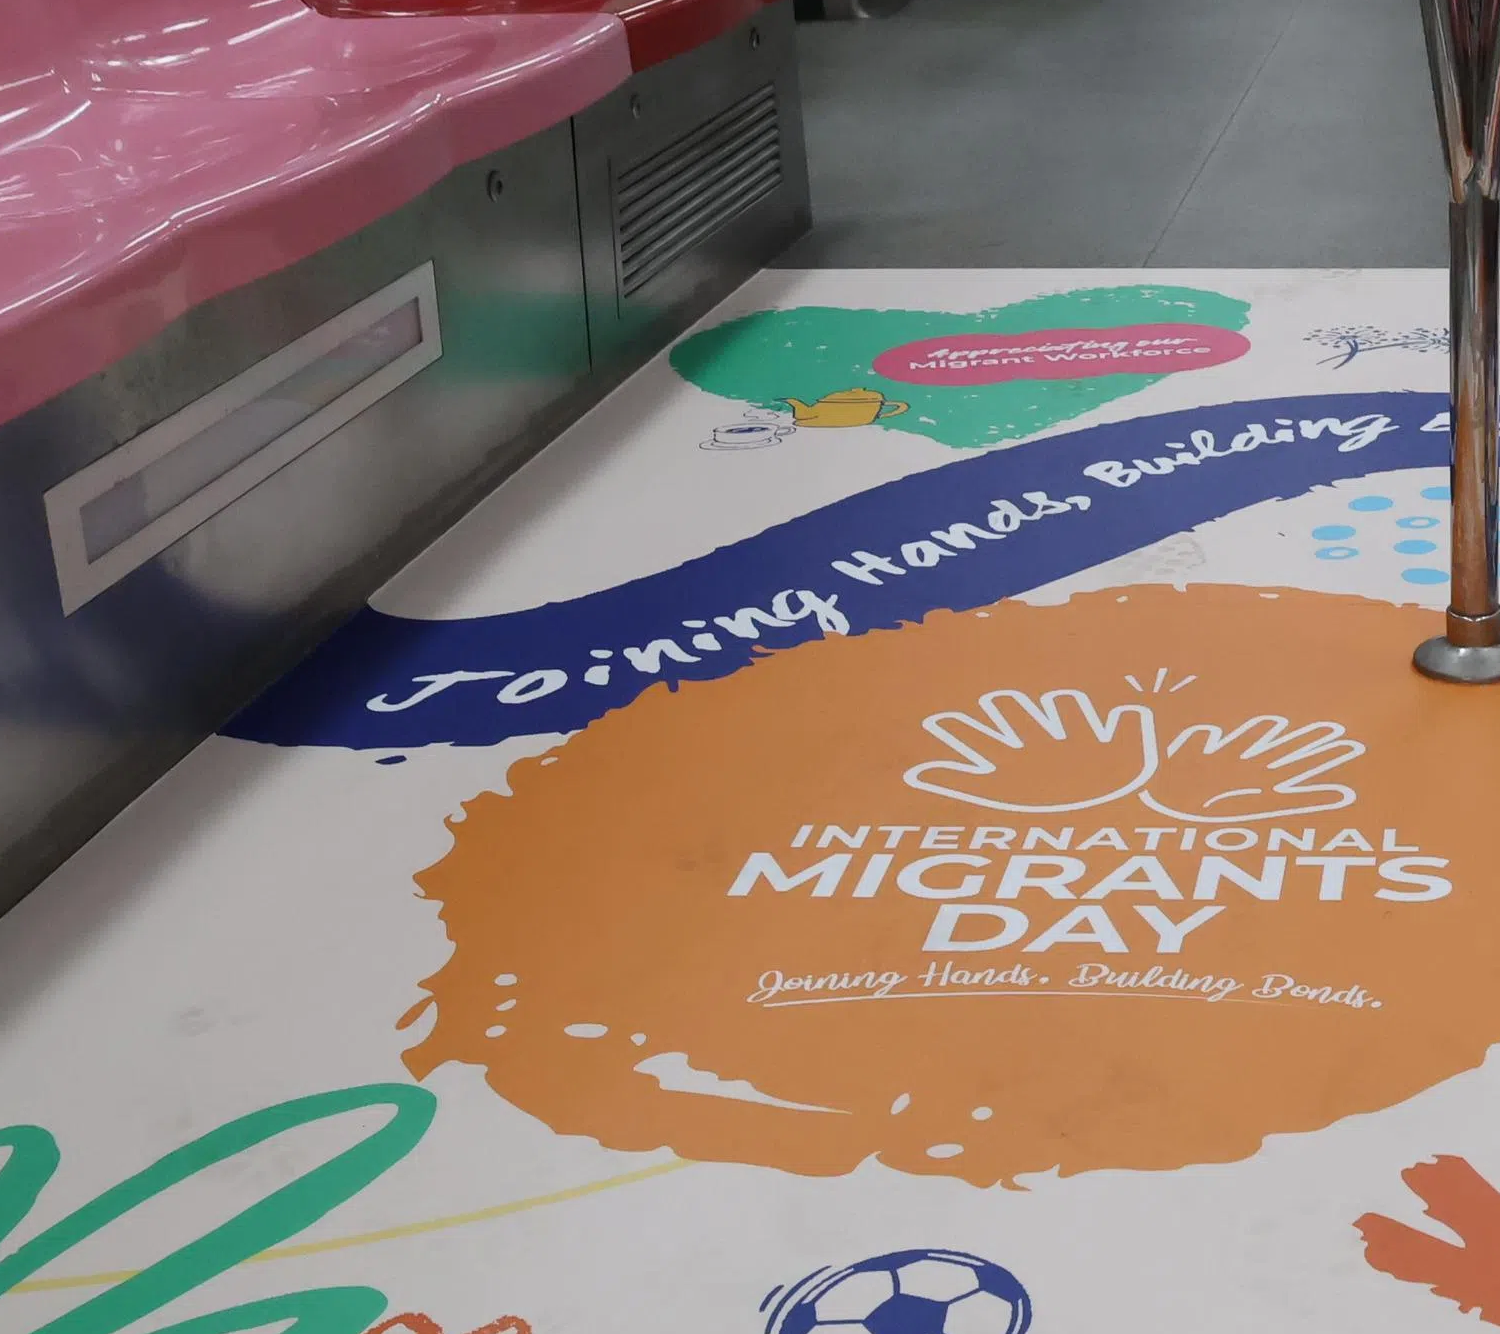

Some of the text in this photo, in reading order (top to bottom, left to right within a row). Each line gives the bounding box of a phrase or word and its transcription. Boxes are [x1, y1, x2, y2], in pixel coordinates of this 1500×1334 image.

[909, 344, 1212, 370] Migrant Workforce
[927, 335, 1198, 361] Appreciating our
[366, 588, 849, 713] Joining
[831, 491, 1091, 586] Hands,
[1083, 412, 1400, 489] Building
[790, 824, 1421, 853] INTERNATIONAL
[726, 853, 1454, 903] MIGRANTS
[921, 903, 1228, 955] DAY
[747, 961, 1383, 1009] Joining Hands. Building Bonds.
